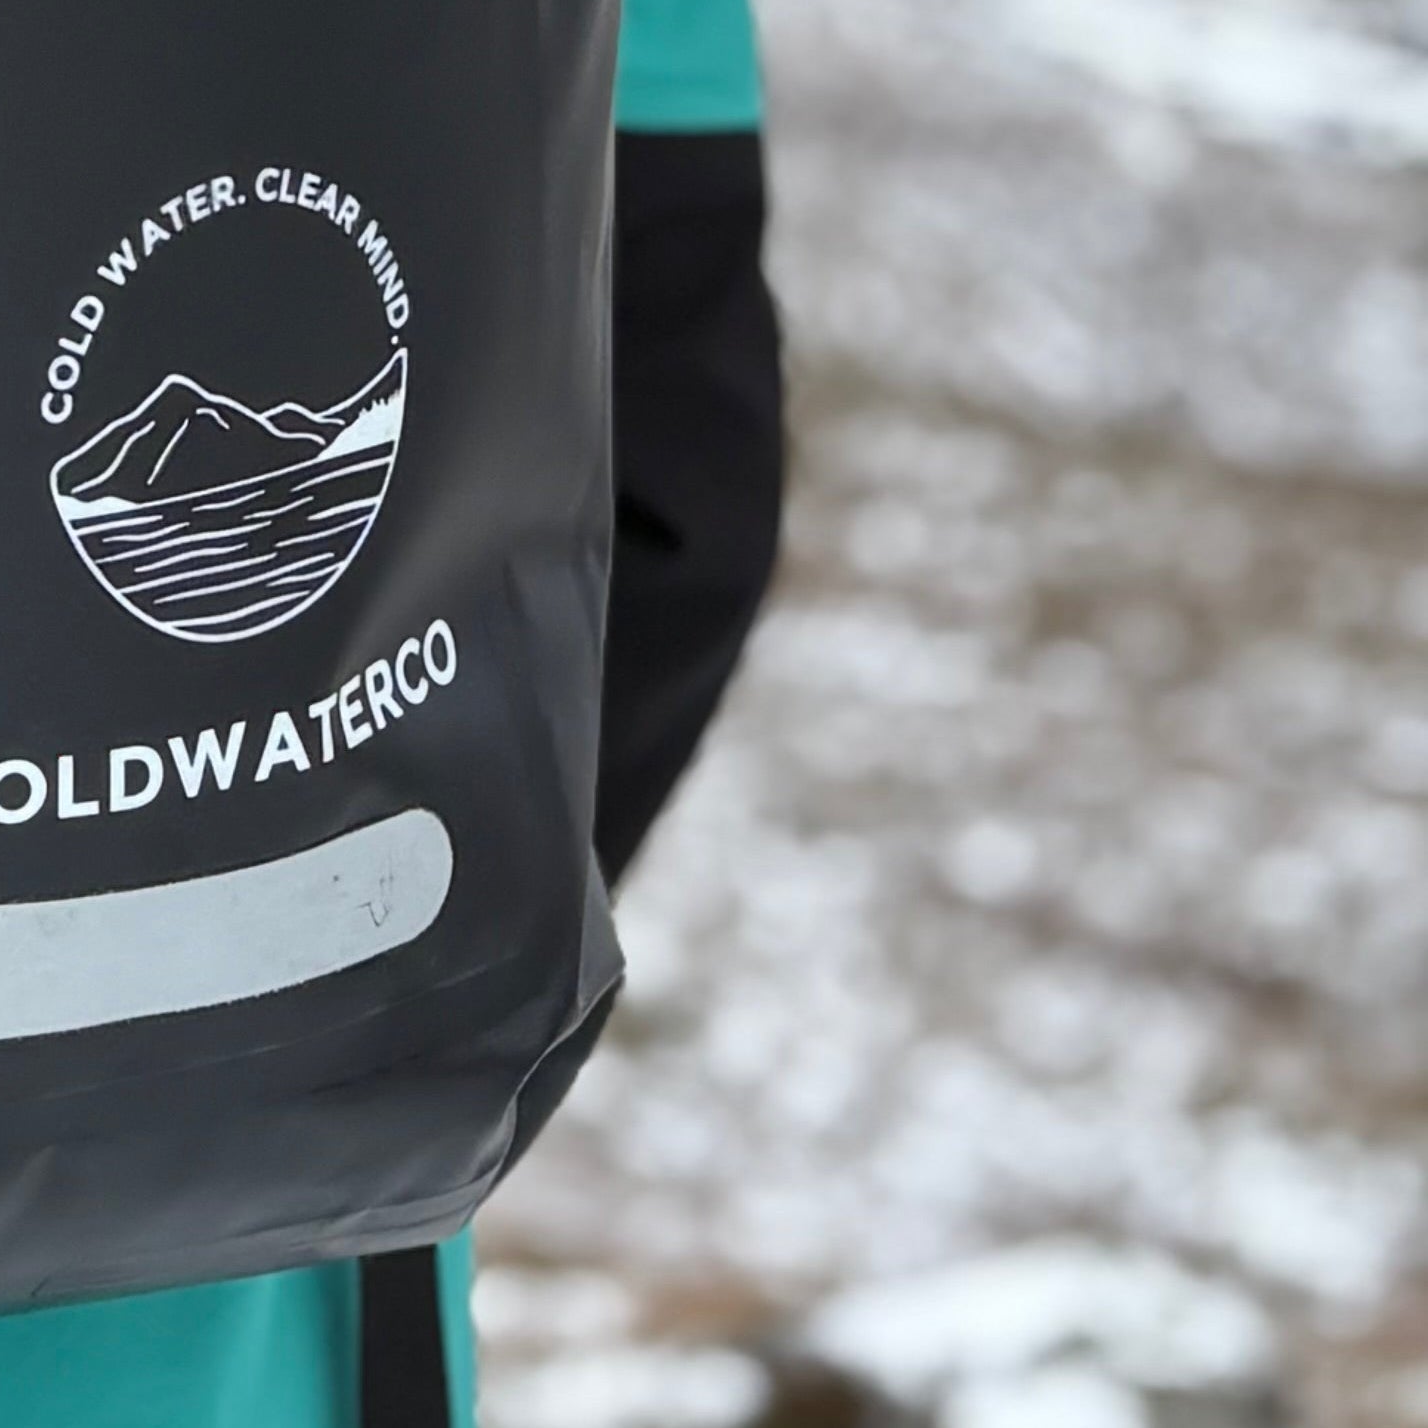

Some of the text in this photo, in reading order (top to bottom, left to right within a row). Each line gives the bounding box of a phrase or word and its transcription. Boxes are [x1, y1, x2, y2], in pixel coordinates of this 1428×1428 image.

[41, 166, 411, 425] COLD WATER. CLEAR MIND.
